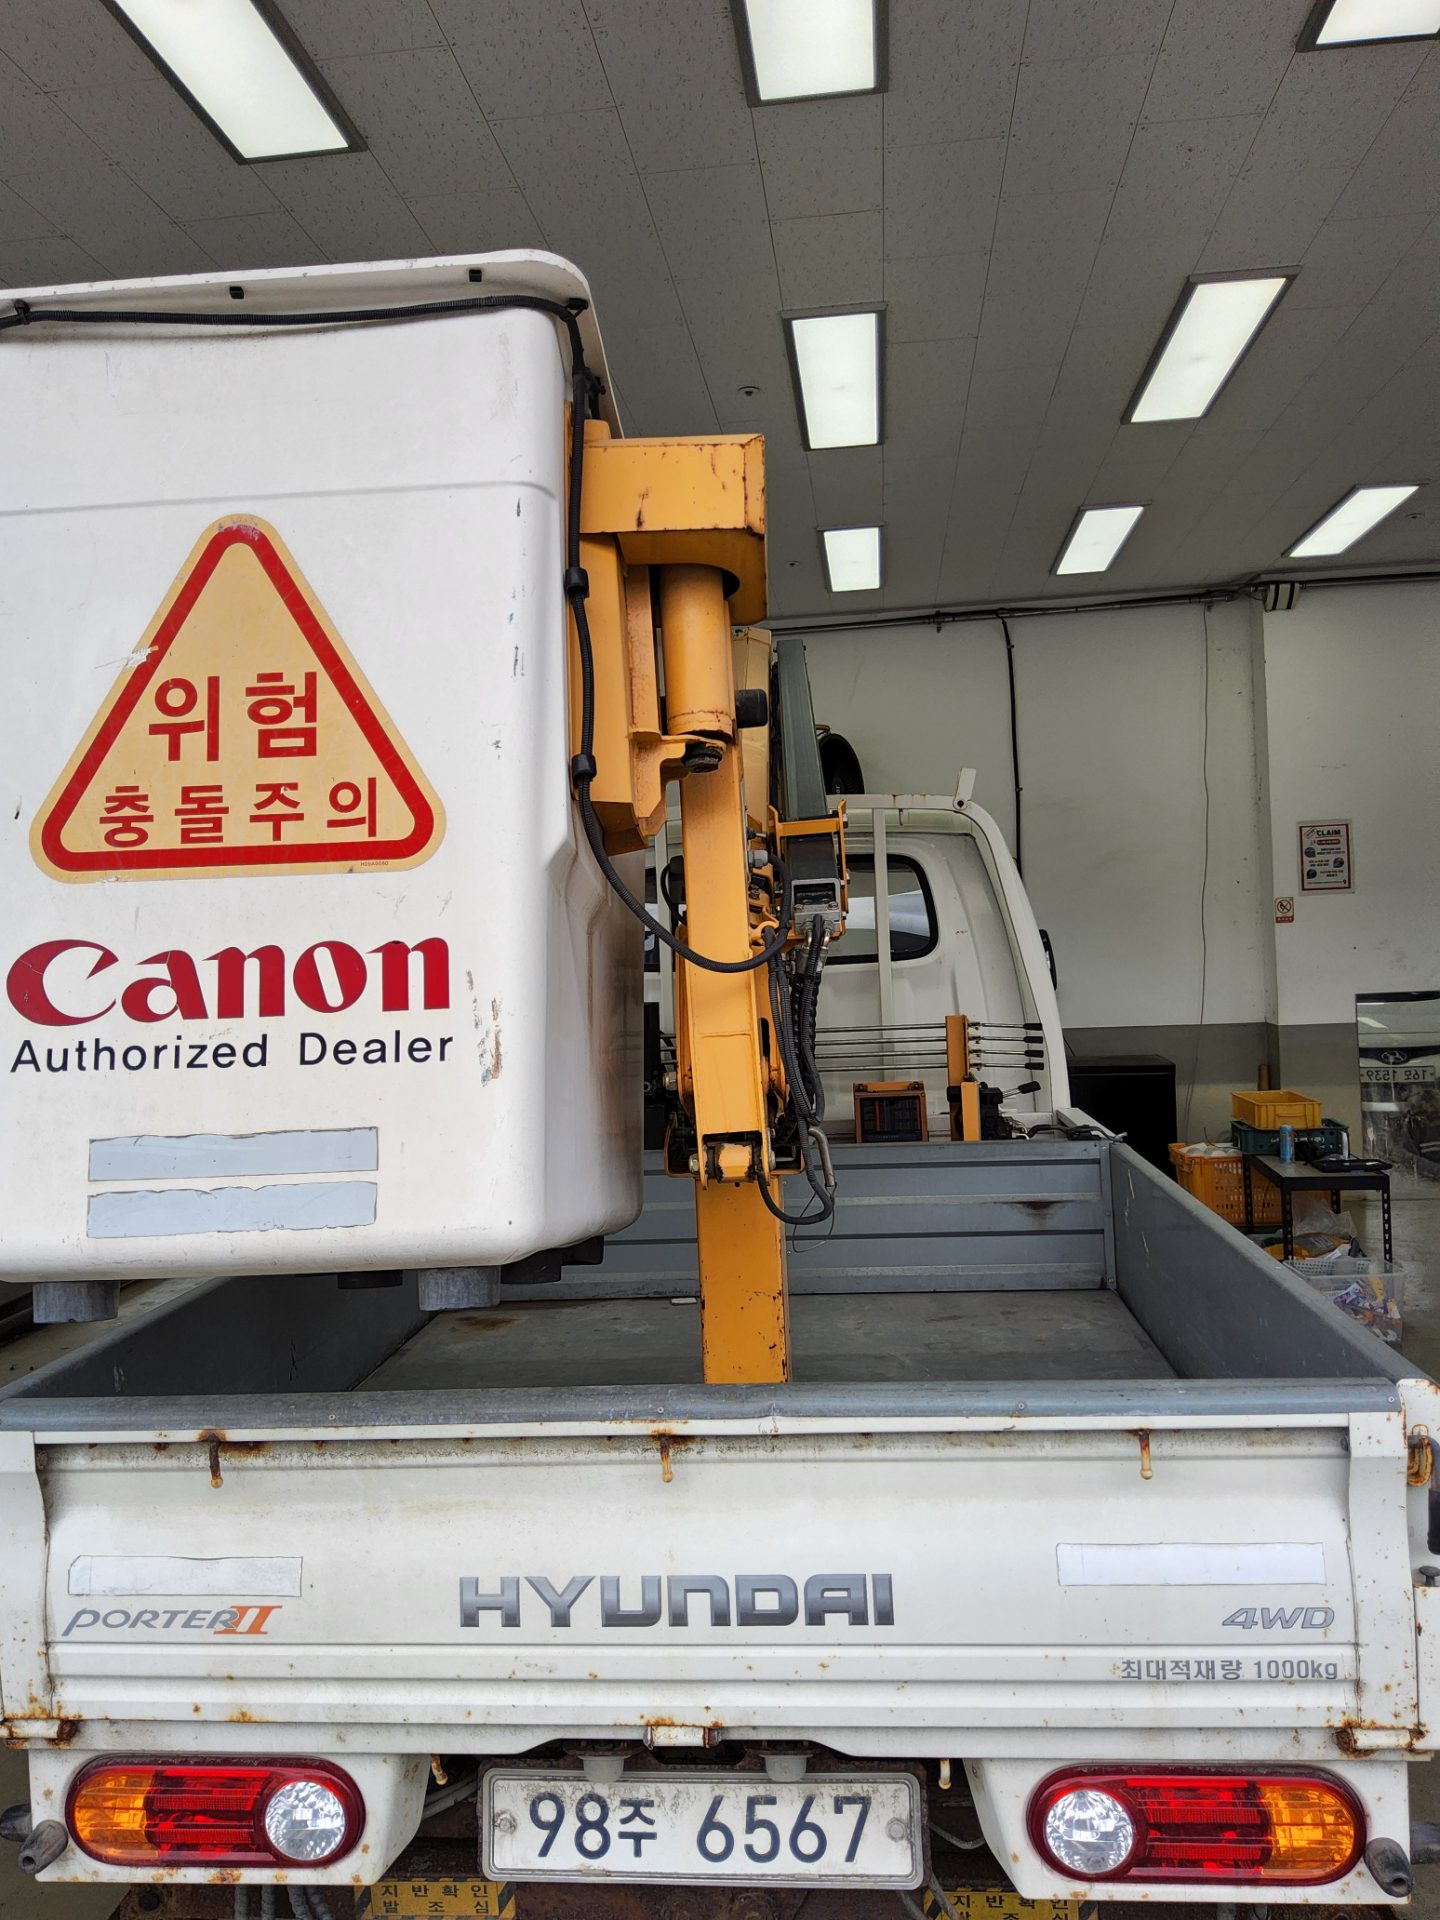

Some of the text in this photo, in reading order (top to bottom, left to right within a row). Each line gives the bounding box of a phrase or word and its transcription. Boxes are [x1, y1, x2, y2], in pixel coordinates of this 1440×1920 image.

[147, 670, 319, 763] 위험
[5, 936, 451, 1027] Canon
[10, 1030, 454, 1073] Authorized Dealer
[458, 1572, 896, 1628] HYUNDAI
[1221, 1606, 1336, 1630] 4WD
[1120, 1658, 1339, 1681] 최대적재량 1000kg
[528, 1791, 873, 1864] 98주 6567
